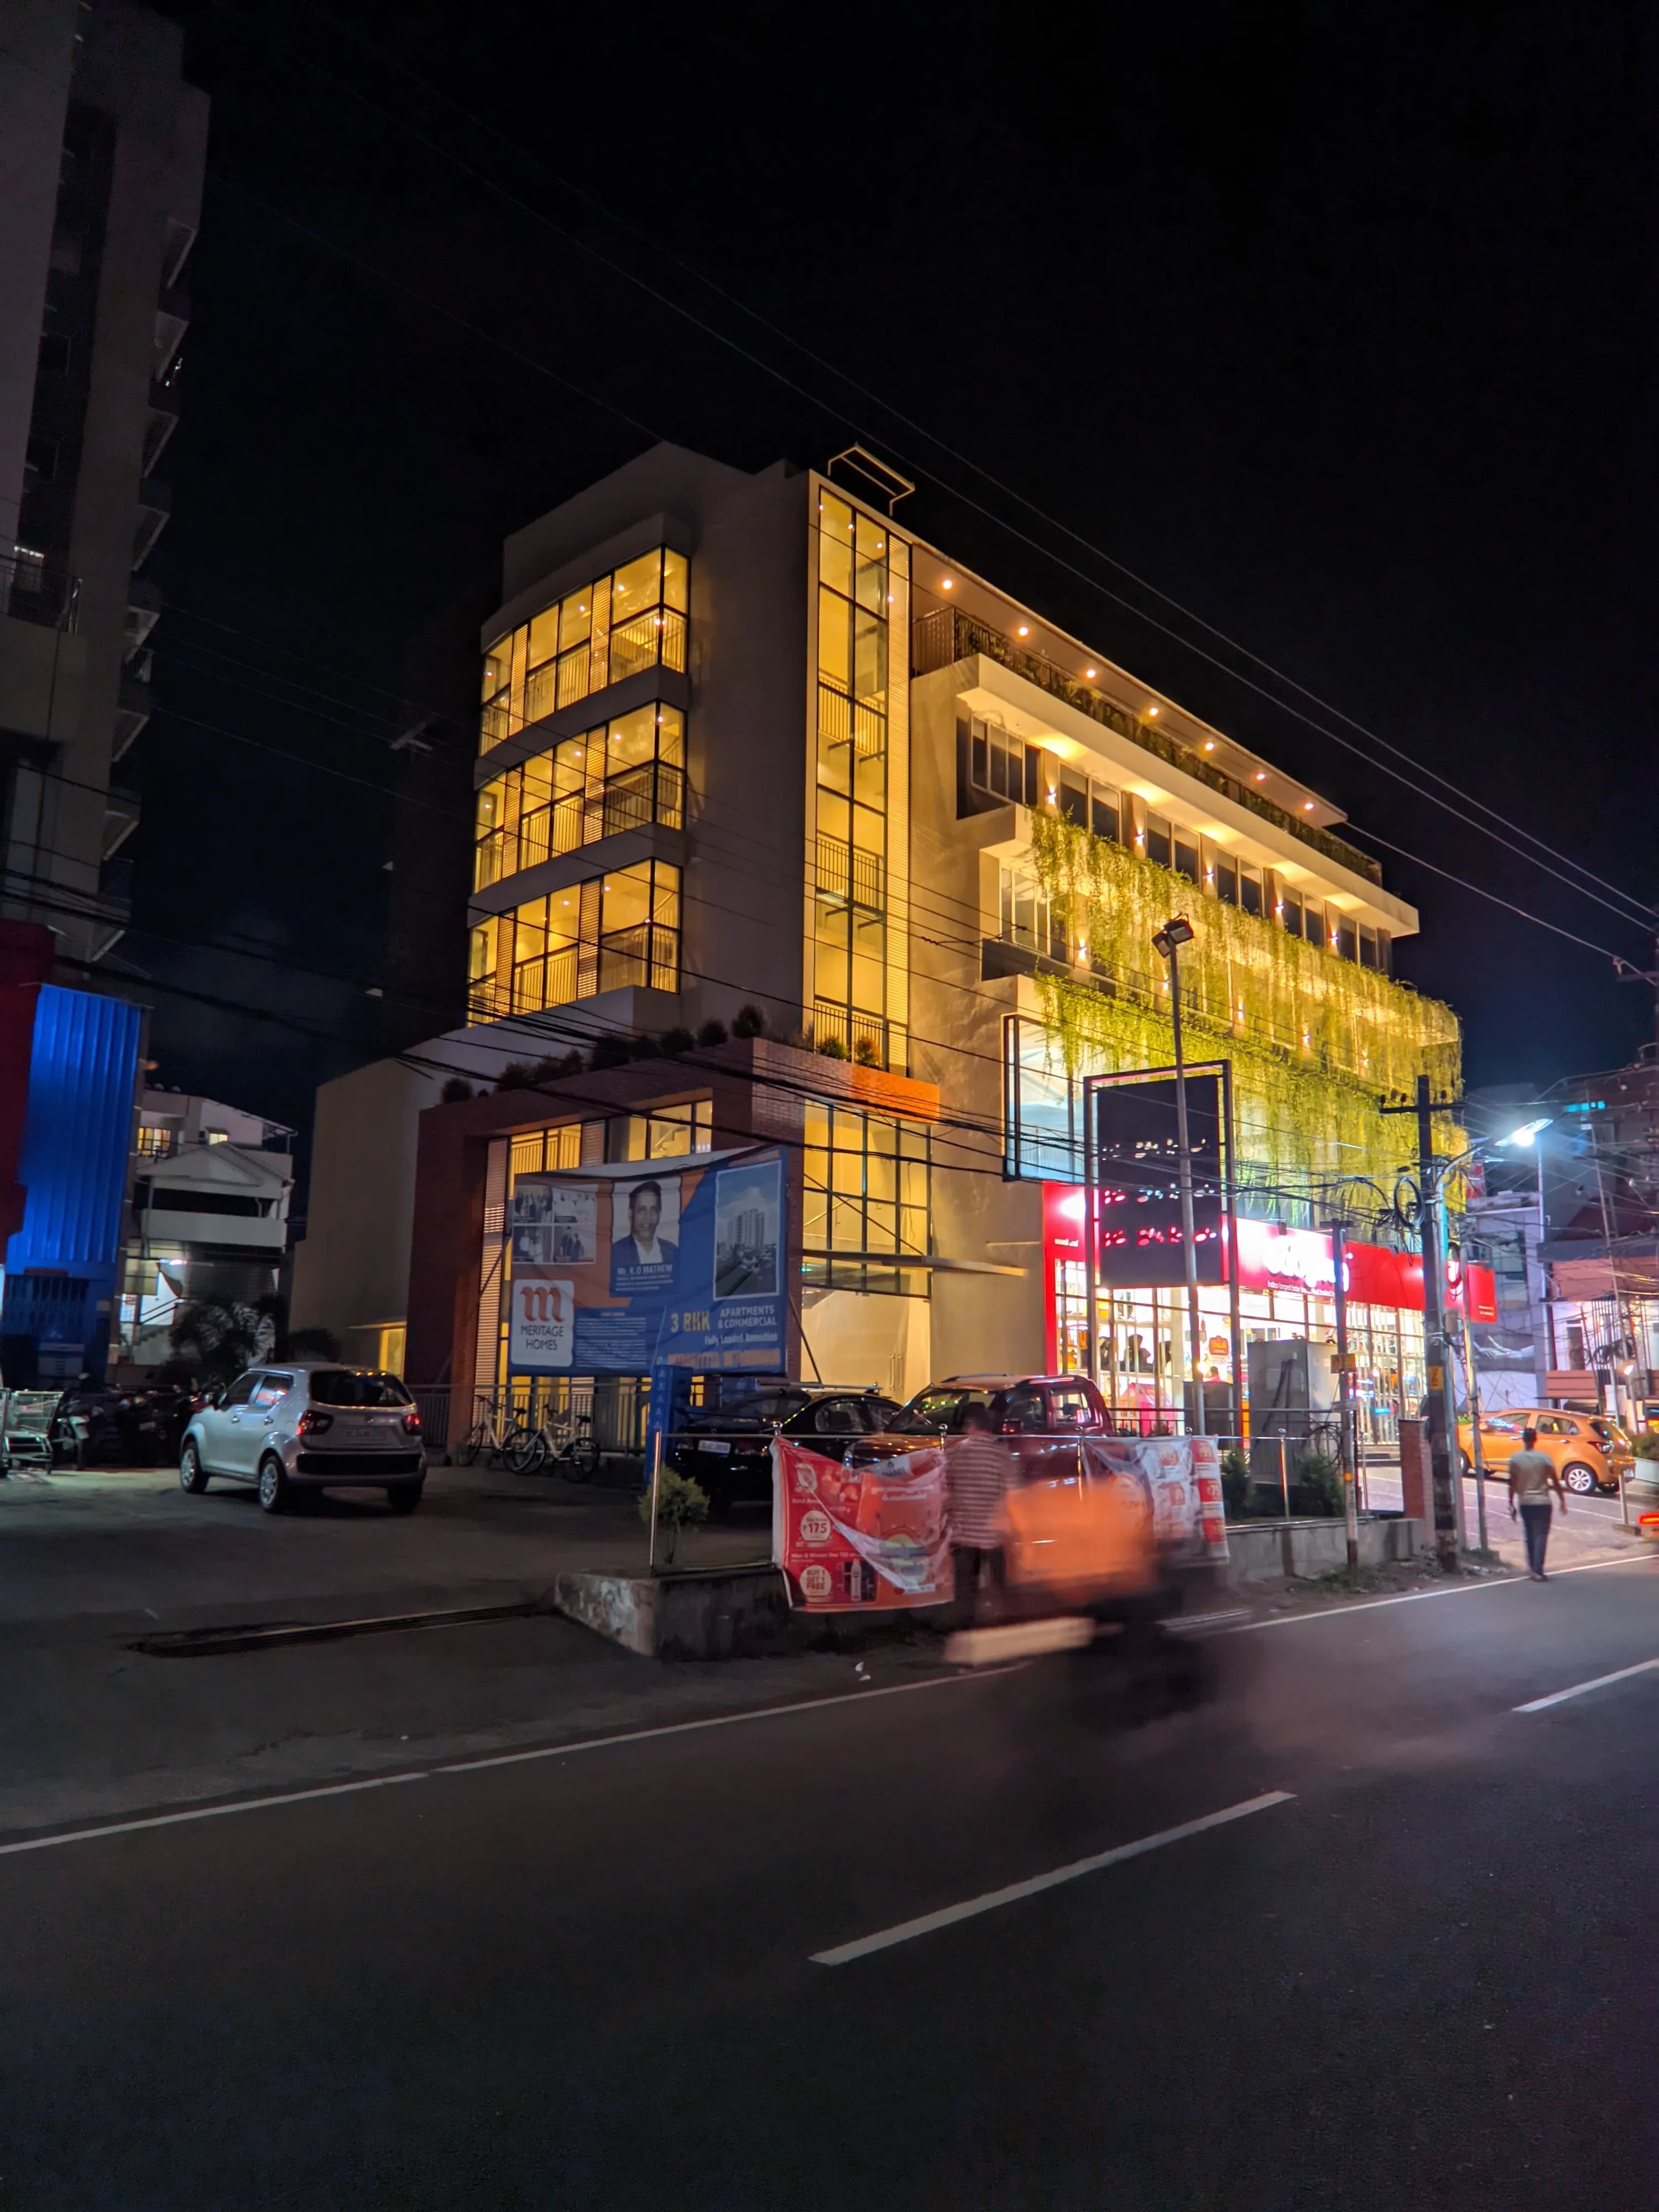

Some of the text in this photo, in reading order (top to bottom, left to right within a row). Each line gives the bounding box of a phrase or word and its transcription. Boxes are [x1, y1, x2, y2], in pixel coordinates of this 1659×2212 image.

[643, 1264, 673, 1274] MATHEW
[720, 1305, 775, 1318] APARTMENTS
[671, 1313, 679, 1333] 3
[724, 1316, 777, 1328] COMMERCIAL
[520, 1325, 564, 1337] MERITAGE
[526, 1339, 557, 1350] HOMES
[705, 1335, 719, 1346] Fully
